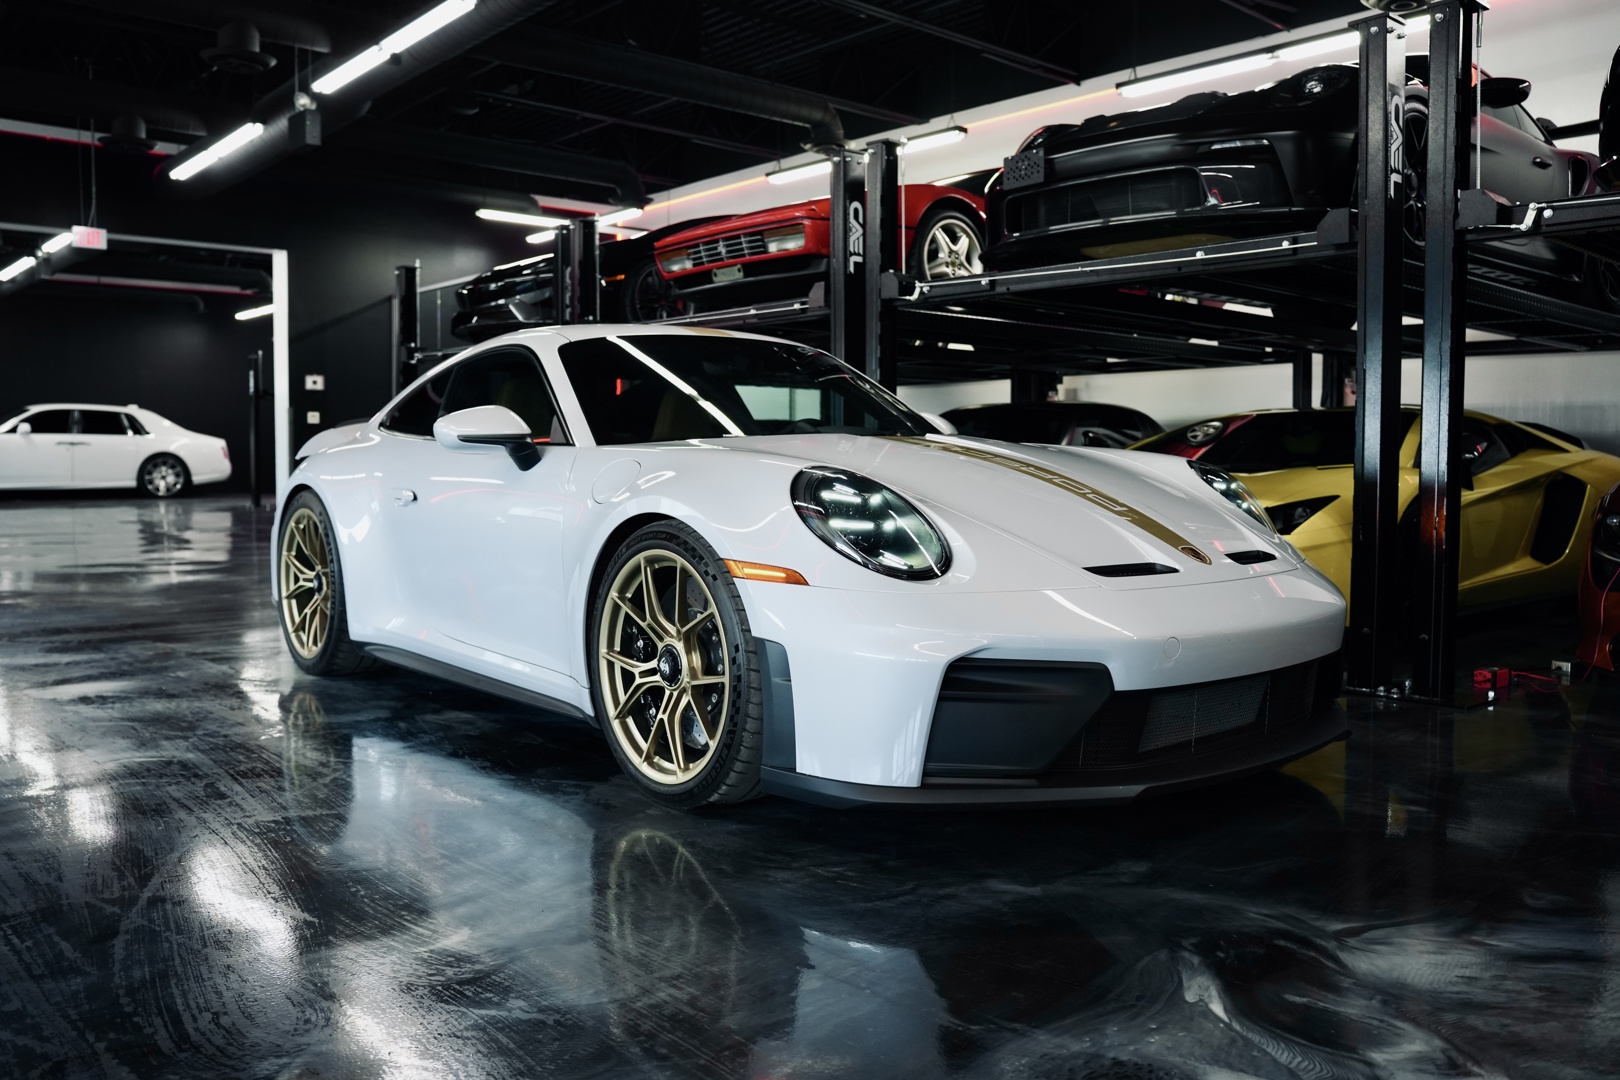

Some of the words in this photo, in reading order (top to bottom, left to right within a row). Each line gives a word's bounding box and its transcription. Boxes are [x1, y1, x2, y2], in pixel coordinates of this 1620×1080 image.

[1390, 95, 1403, 199] CAEL
[850, 200, 864, 275] CAEL
[692, 746, 729, 797] MICHELIN
